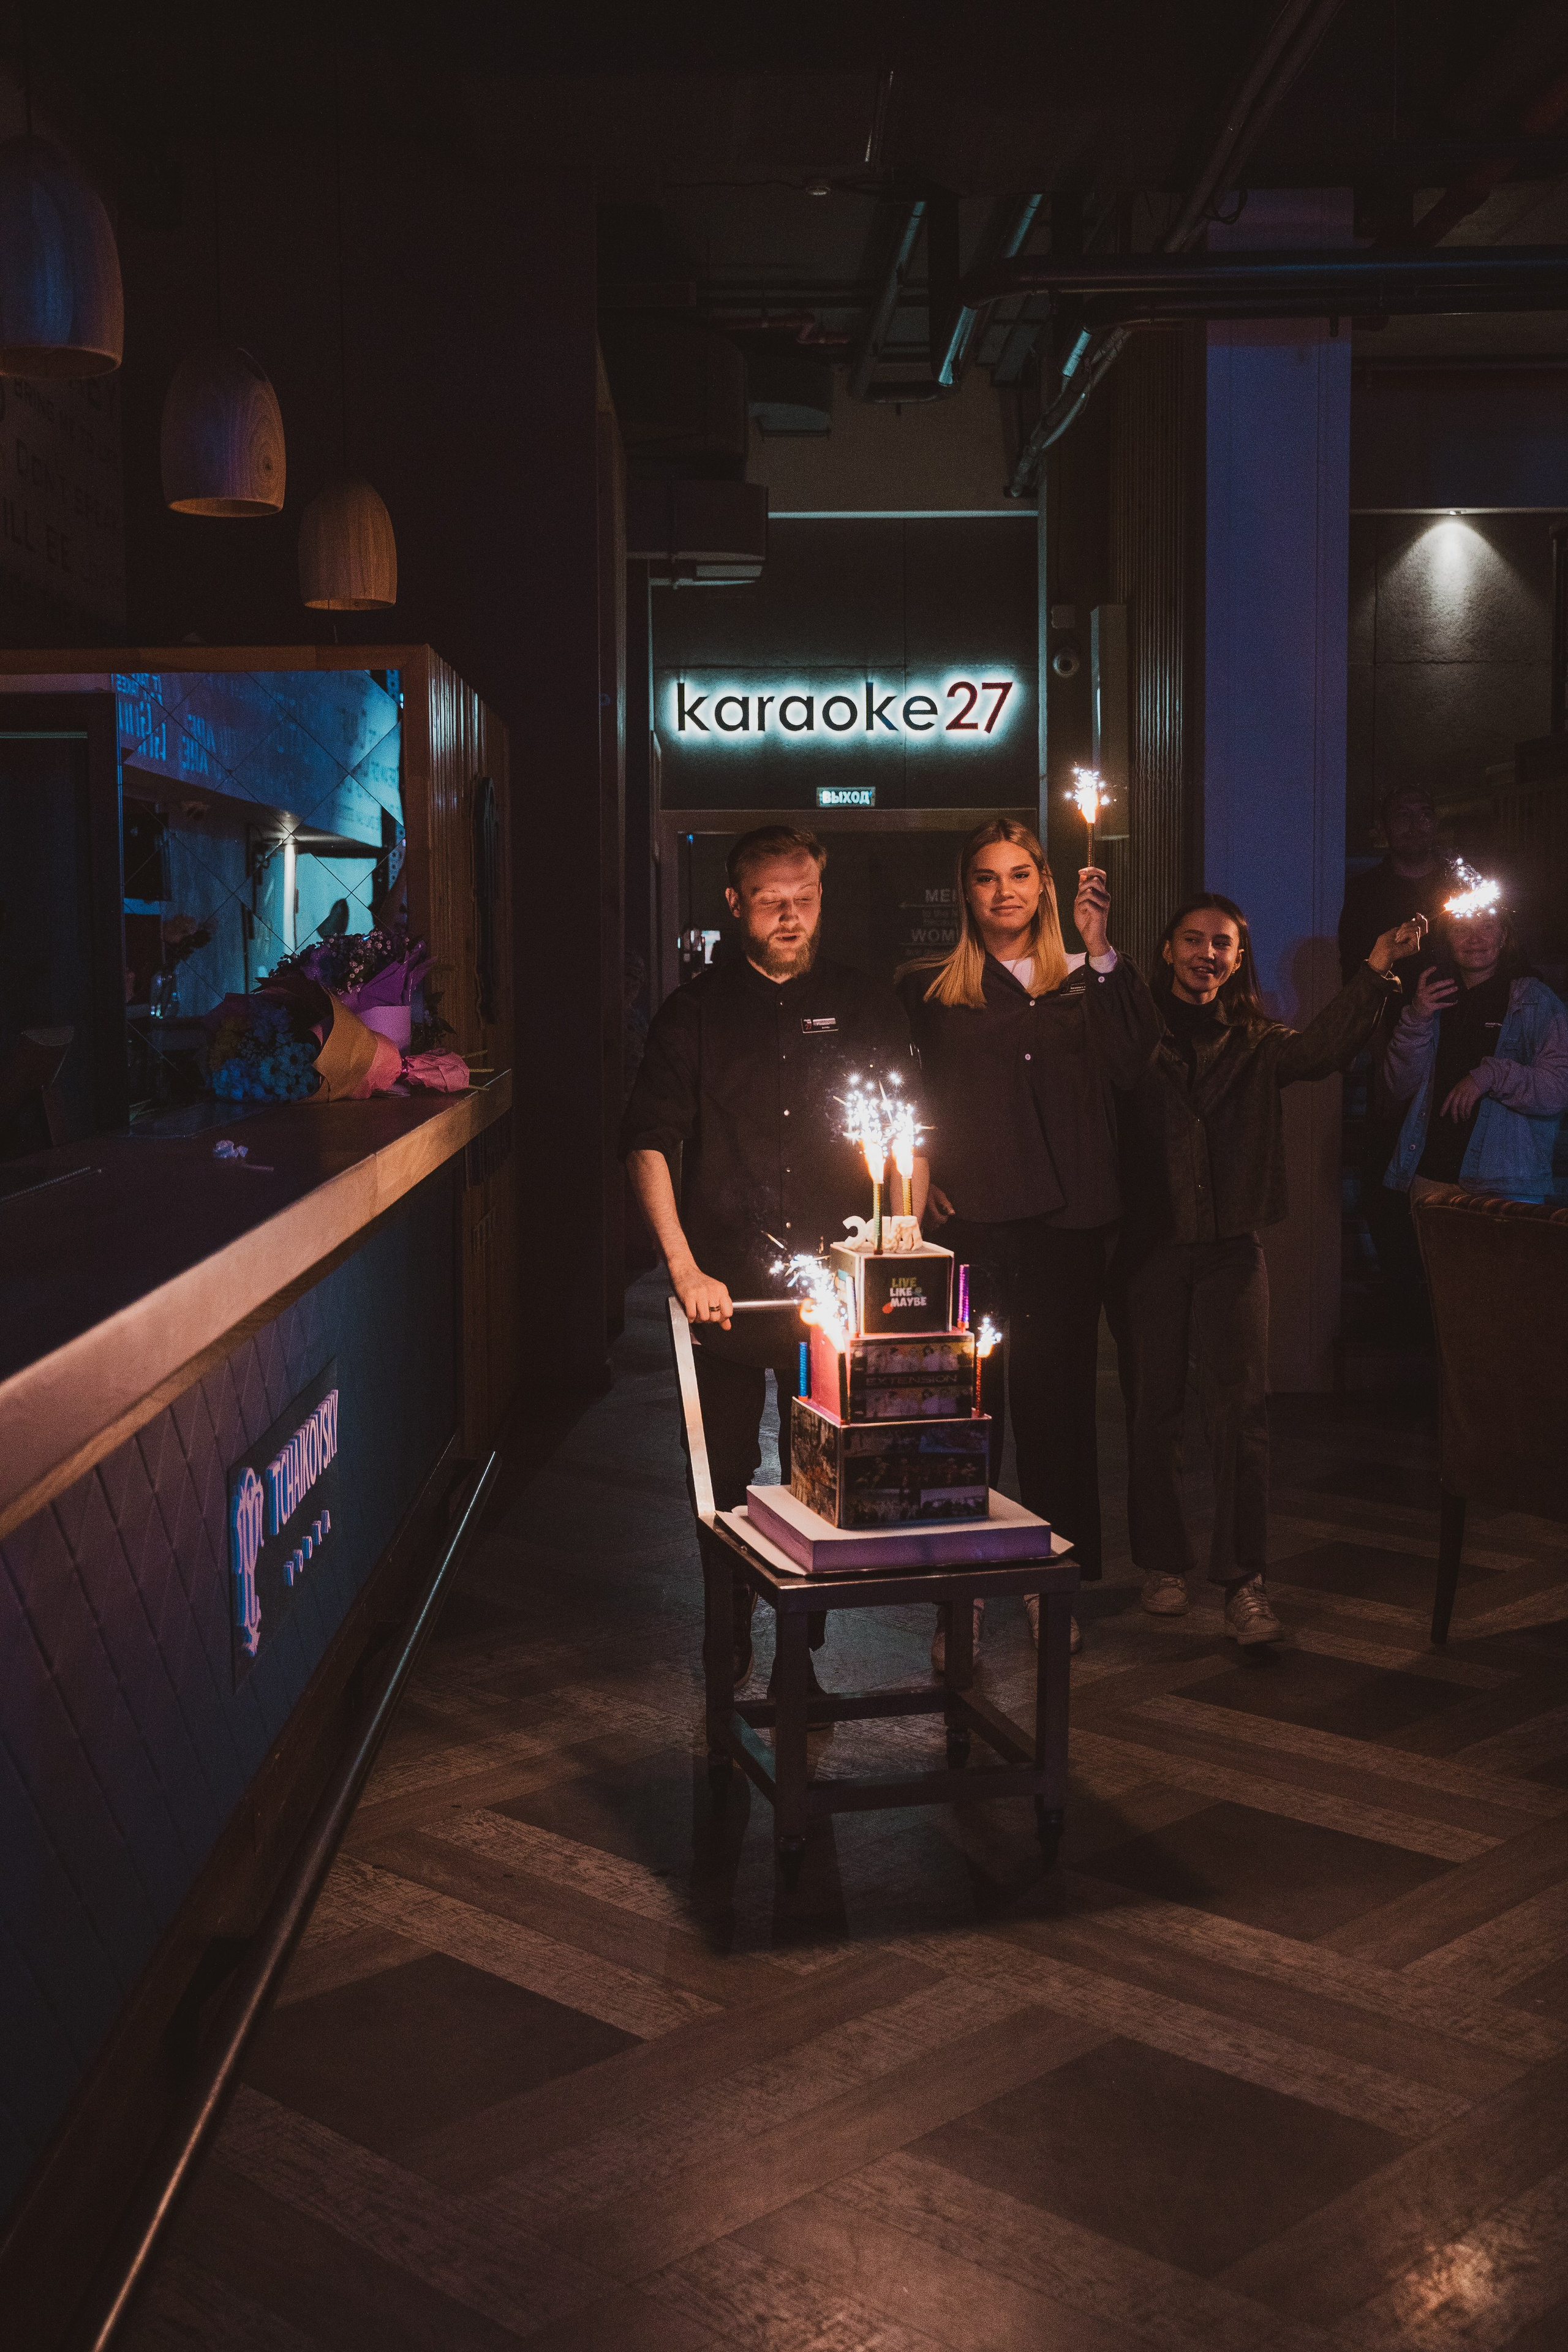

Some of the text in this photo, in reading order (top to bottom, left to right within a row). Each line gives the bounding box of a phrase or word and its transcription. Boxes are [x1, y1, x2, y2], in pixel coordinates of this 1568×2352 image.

[822, 791, 870, 804] ВЫХОД
[910, 929, 959, 943] WOM
[892, 1277, 918, 1287] LIVE
[889, 1287, 913, 1297] LIKE
[891, 1297, 927, 1307] MAYBE
[865, 1373, 958, 1387] EXTENSION
